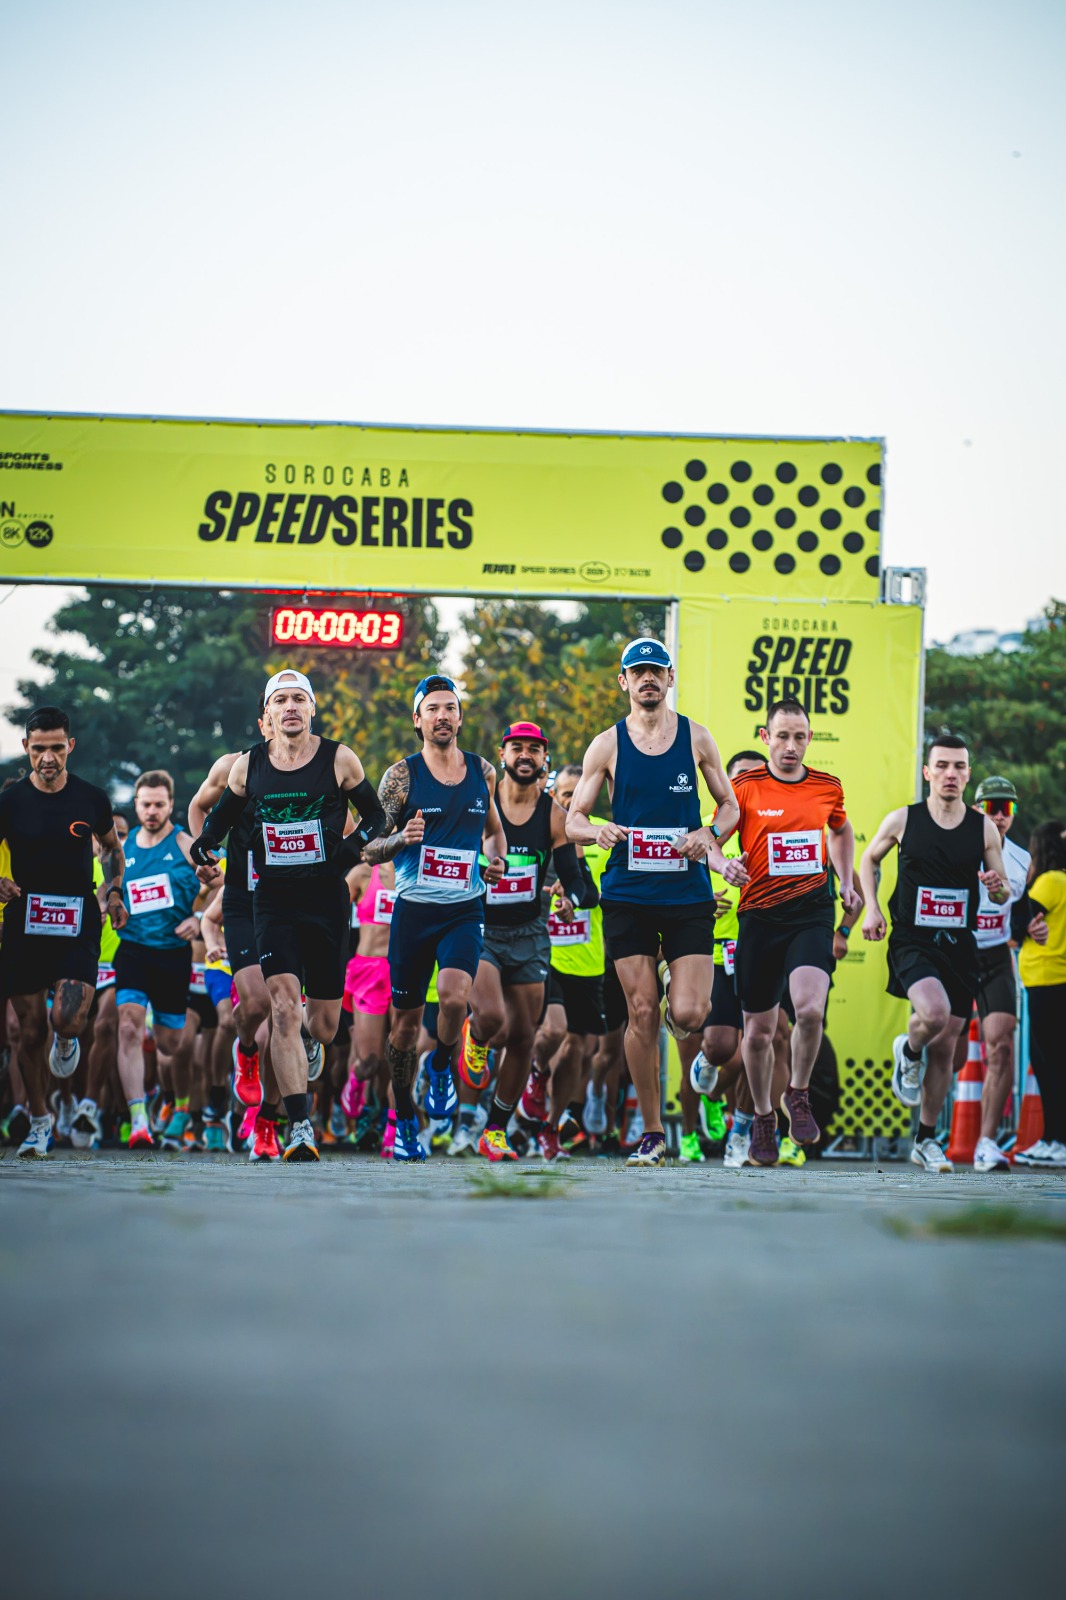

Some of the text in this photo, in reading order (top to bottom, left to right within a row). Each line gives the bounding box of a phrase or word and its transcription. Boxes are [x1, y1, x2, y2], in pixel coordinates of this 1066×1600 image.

[265, 463, 409, 487] SOROCABA
[198, 490, 474, 549] SPEEDSERIES
[28, 527, 50, 540] 12K
[275, 610, 400, 643] 00:00:03
[762, 617, 838, 632] SOROCABA
[747, 635, 853, 676] SPEED
[744, 675, 850, 715] SERIES
[279, 839, 306, 851] 409
[645, 845, 672, 857] 112
[785, 848, 810, 861] 265
[435, 864, 460, 877] 125
[510, 881, 518, 892] 8
[932, 904, 956, 916] 169
[41, 911, 66, 923] 210
[557, 924, 578, 935] 211
